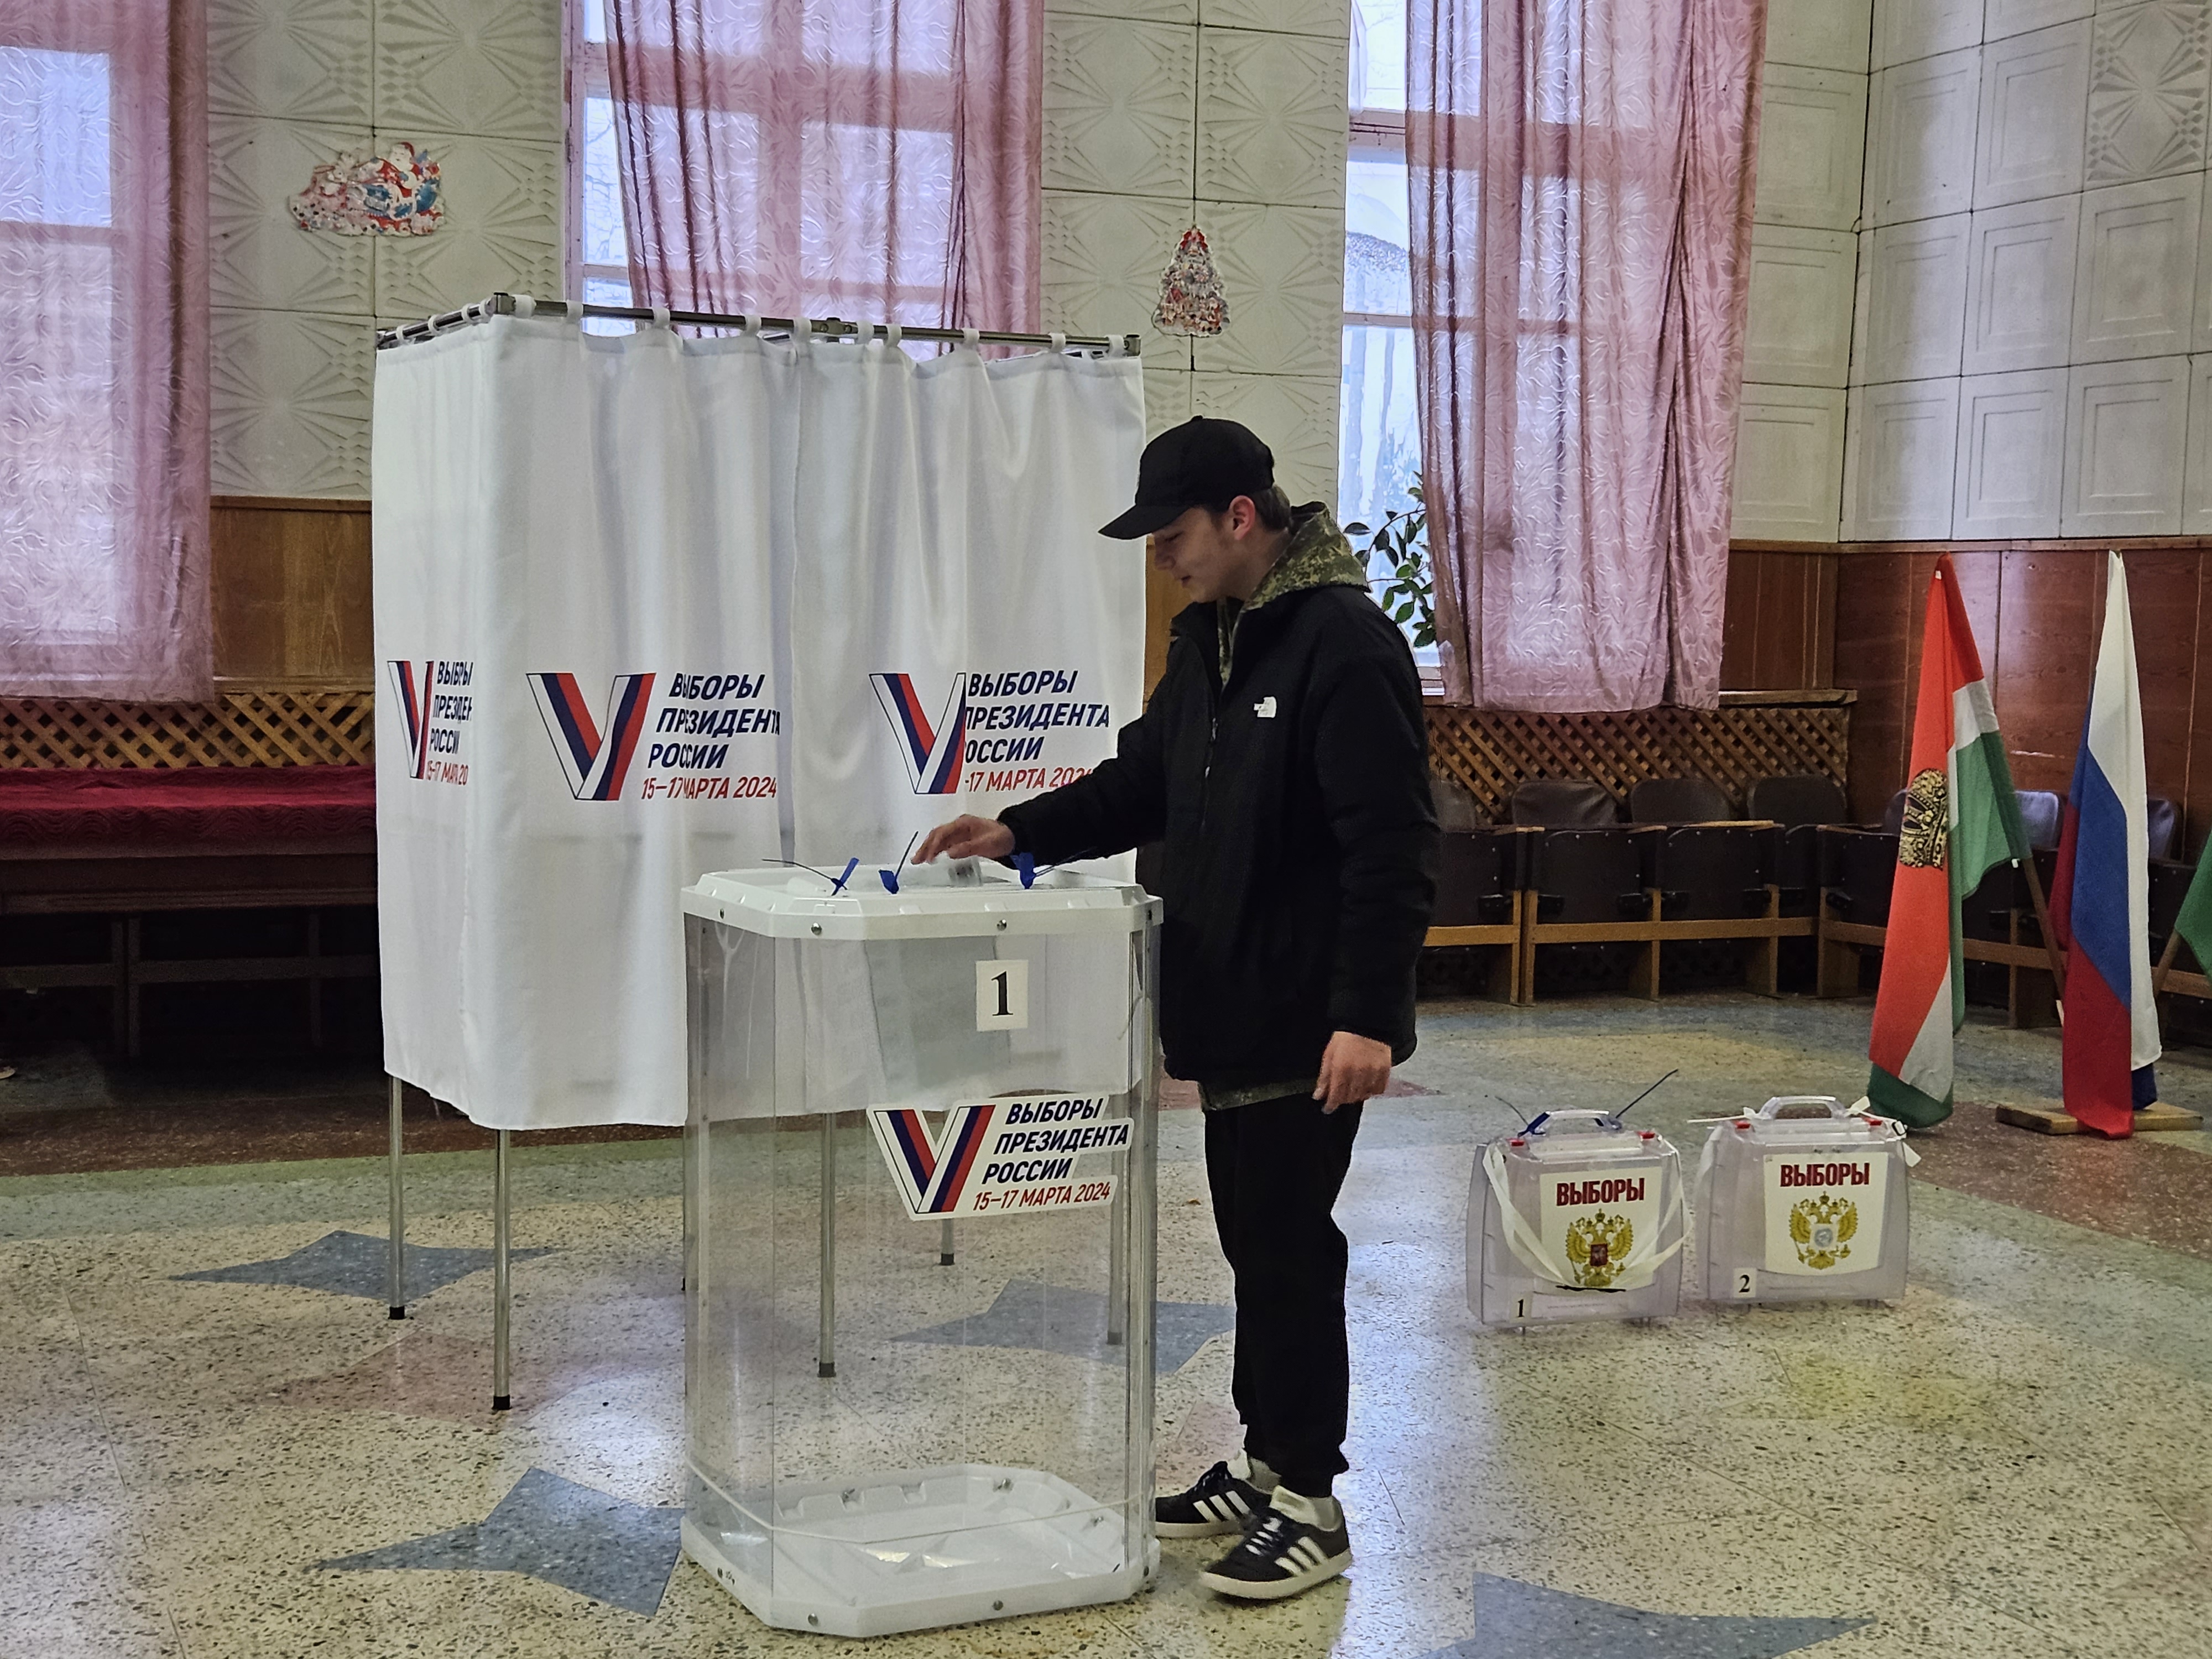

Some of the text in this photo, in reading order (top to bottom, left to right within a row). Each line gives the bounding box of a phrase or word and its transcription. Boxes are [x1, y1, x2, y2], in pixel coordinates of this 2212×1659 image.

[669, 673, 765, 700] ВЫБОРЫ
[968, 670, 1078, 697] ВЫБОРЫ
[648, 743, 729, 769] РОССИИ
[964, 737, 1045, 764] ОССИИ
[733, 776, 776, 798] 2024
[985, 768, 1046, 792] МАРТА
[1048, 767, 1092, 787] 202
[991, 971, 1014, 1016] 1
[1005, 1098, 1104, 1125] ВЫБОРЫ
[993, 1124, 1129, 1155] ПРЕЗИДЕНТА
[982, 1157, 1073, 1184] РОССИИ
[1780, 1162, 1870, 1187] ВЫБОРЫ
[1019, 1185, 1072, 1208] МАРТА
[1073, 1181, 1110, 1203] 2024
[1556, 1178, 1645, 1206] ВЫБОРЫ
[1739, 1275, 1750, 1293] 2
[1517, 1298, 1525, 1318] 1
